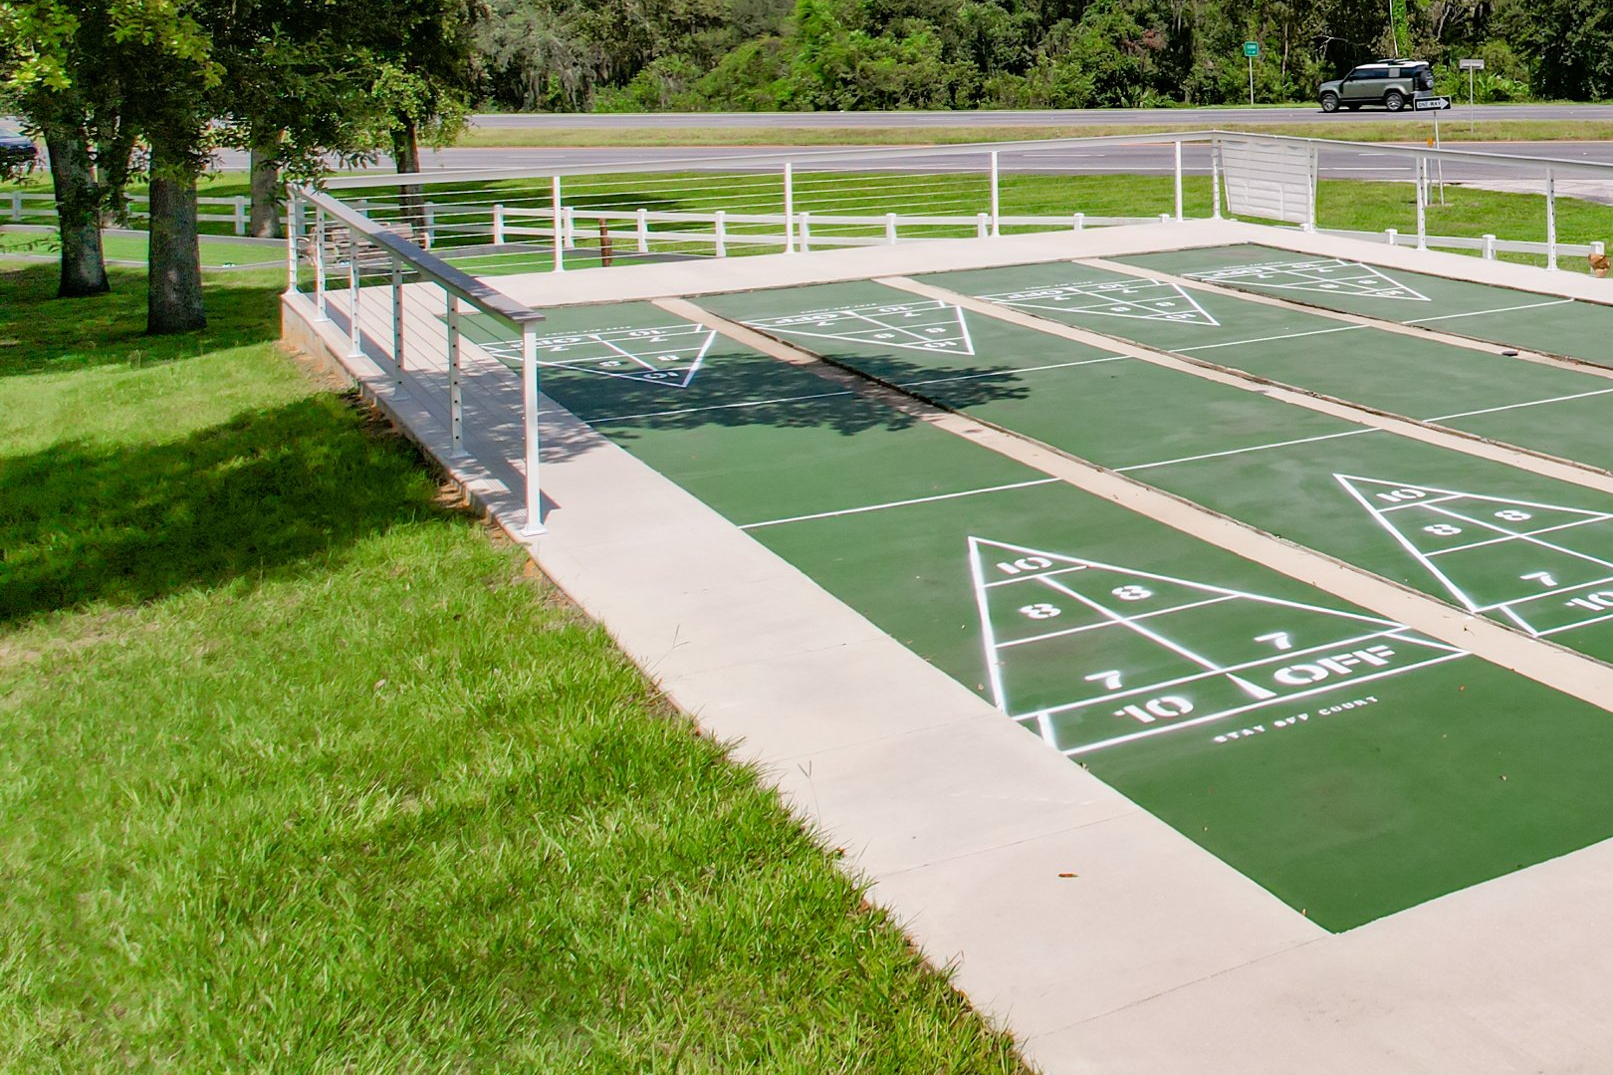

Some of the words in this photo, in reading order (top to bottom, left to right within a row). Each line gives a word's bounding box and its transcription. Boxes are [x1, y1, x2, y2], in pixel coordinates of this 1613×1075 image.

[1376, 488, 1426, 503] 10
[1494, 510, 1532, 521] 8
[1423, 524, 1462, 536] 8
[996, 557, 1054, 574] 10
[1520, 571, 1558, 587] 7
[1111, 585, 1153, 600] 8
[1019, 603, 1062, 619] 8
[1254, 631, 1292, 650] 7
[1084, 670, 1123, 690] 7
[1113, 695, 1194, 723] 10
[1273, 644, 1396, 685] OFF
[1213, 725, 1266, 743] STAY
[1273, 713, 1309, 728] OFF
[1318, 696, 1378, 716] COURT
